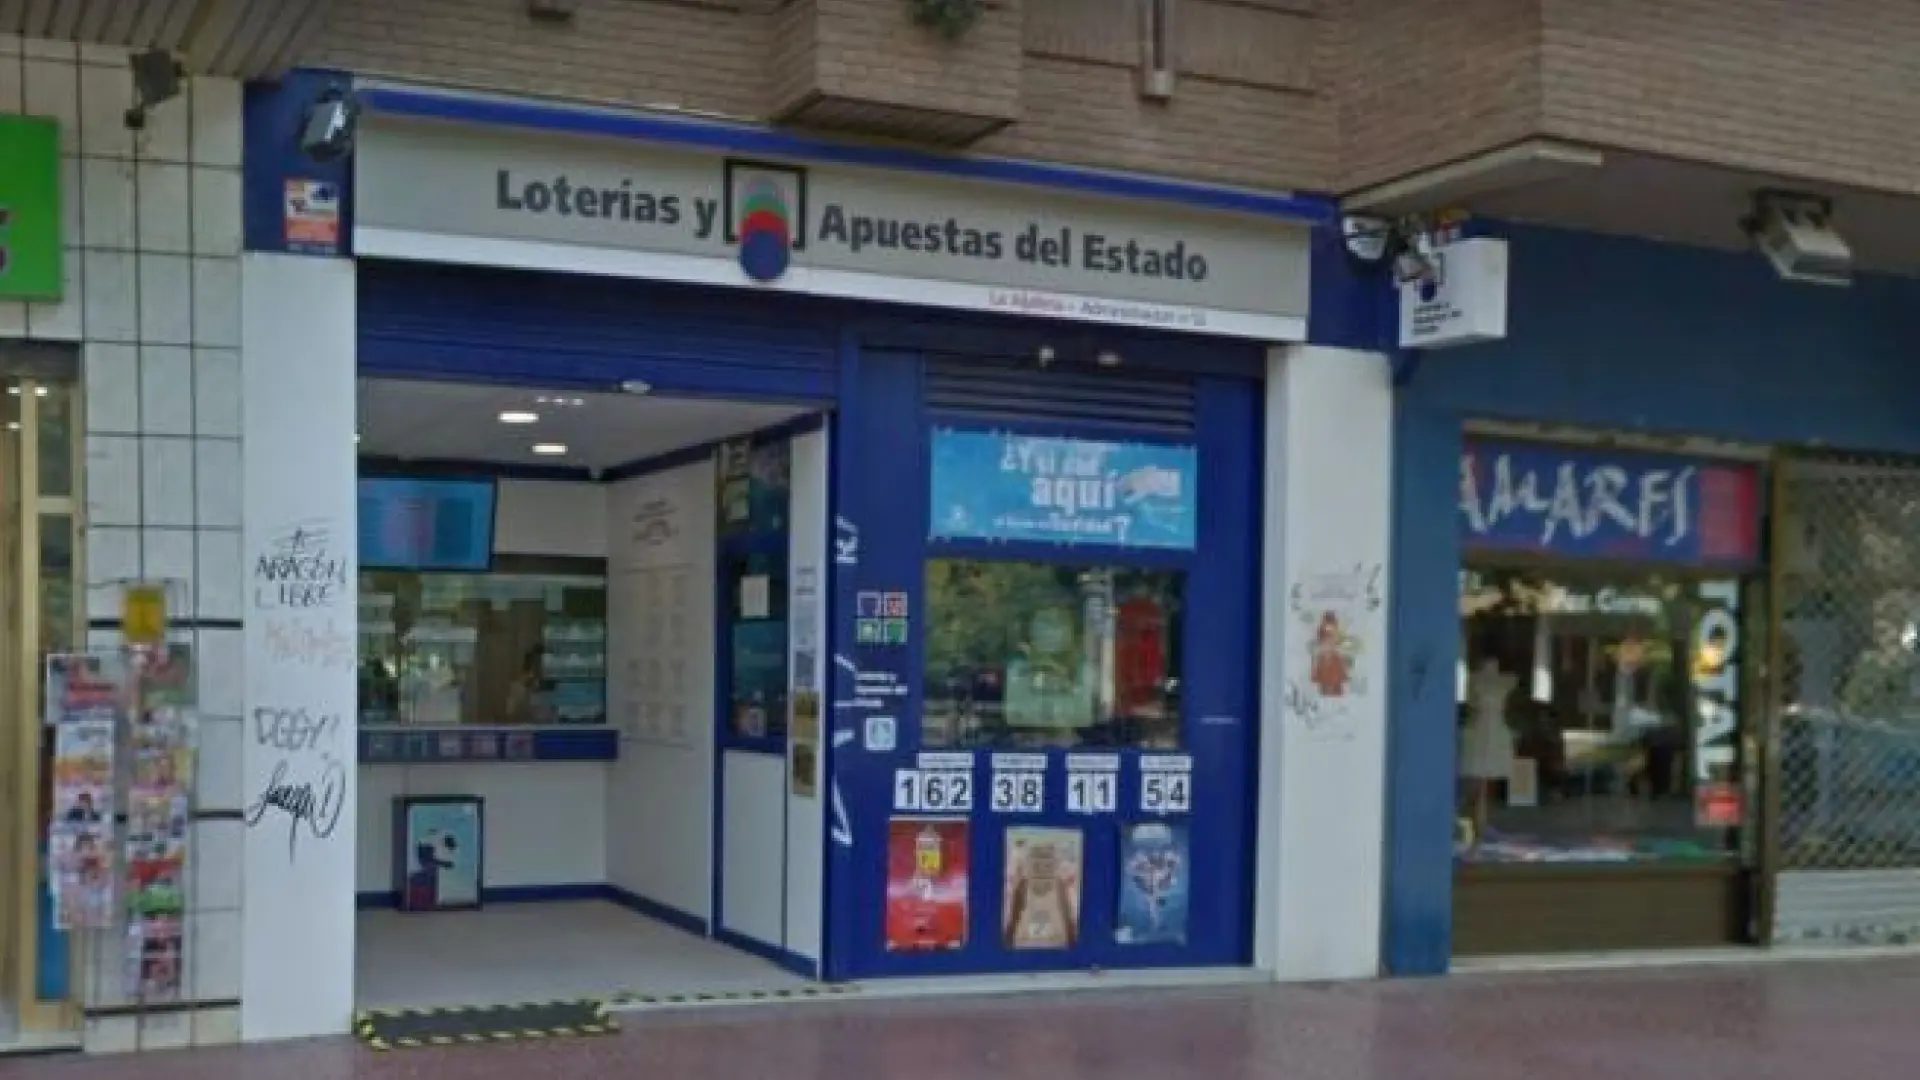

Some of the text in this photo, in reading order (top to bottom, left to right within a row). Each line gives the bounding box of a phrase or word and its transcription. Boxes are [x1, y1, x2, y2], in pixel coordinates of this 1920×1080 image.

[695, 196, 718, 239] y
[818, 204, 1004, 261] Apuestas
[1015, 222, 1072, 267] del
[1082, 233, 1209, 282] Estado
[1031, 469, 1118, 517] aquí
[900, 776, 1187, 808] 162 38 11 54
